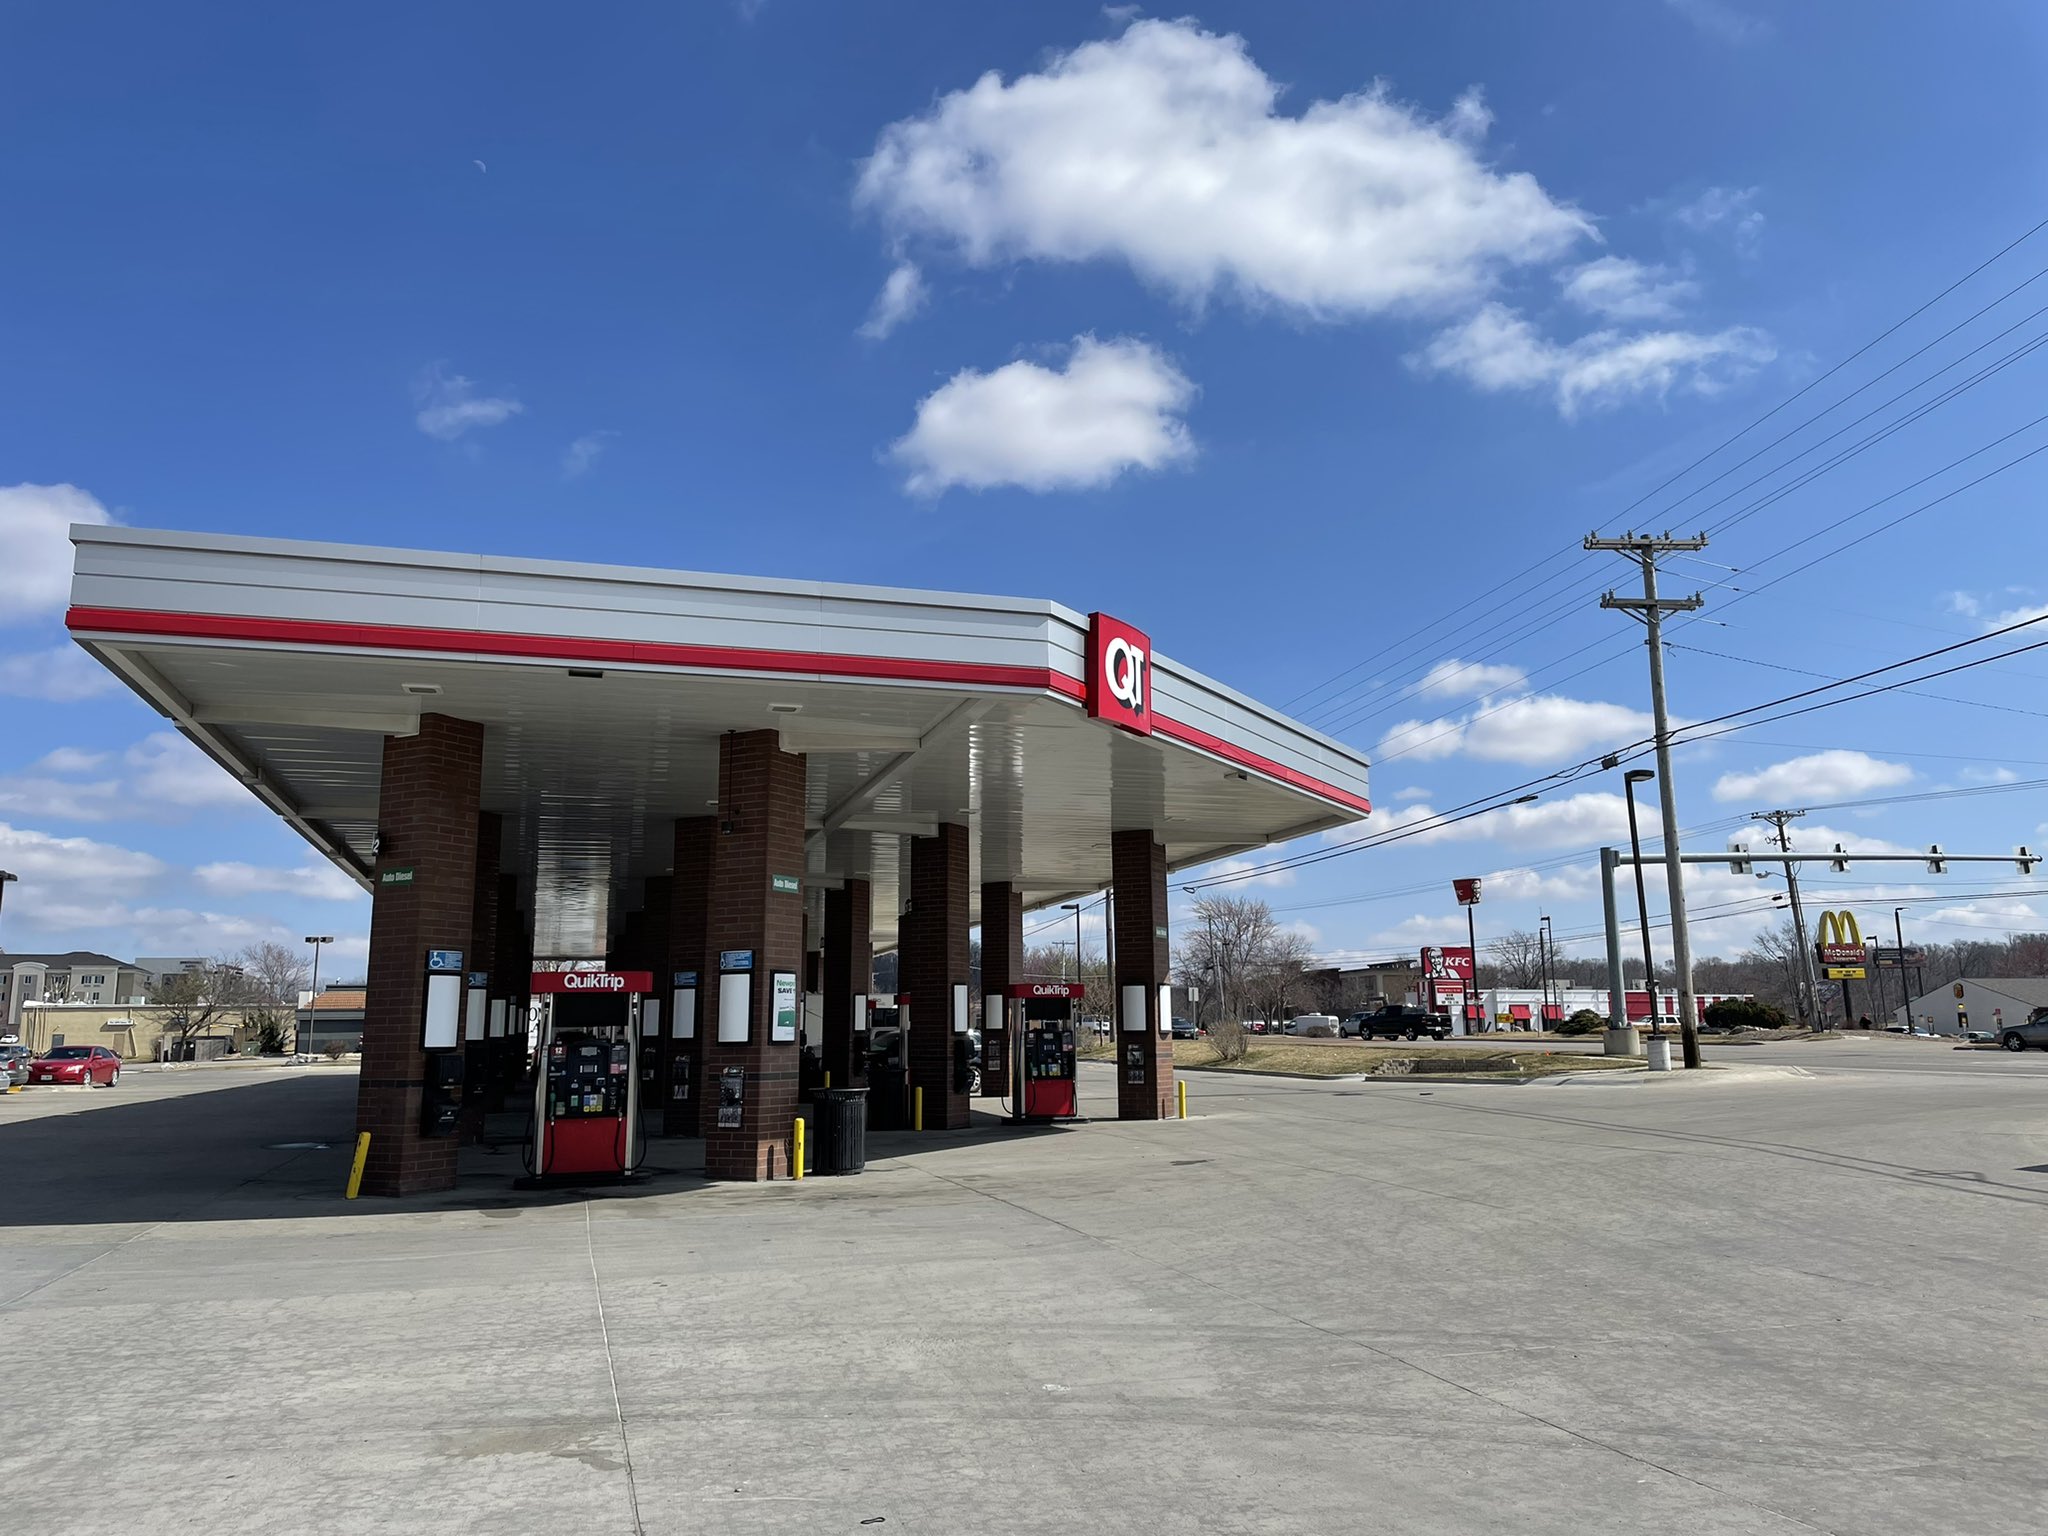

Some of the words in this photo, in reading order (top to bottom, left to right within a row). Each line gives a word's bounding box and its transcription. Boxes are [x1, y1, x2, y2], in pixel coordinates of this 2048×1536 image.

[1105, 637, 1145, 710] QT
[382, 873, 395, 882] Auto
[395, 870, 413, 881] Diesel
[773, 878, 784, 888] Auto
[784, 879, 798, 890] Diesel
[1824, 948, 1865, 957] McDonald's
[1444, 957, 1470, 967] KFC
[564, 973, 625, 991] QuikTrip
[1033, 984, 1070, 997] QuikTrip
